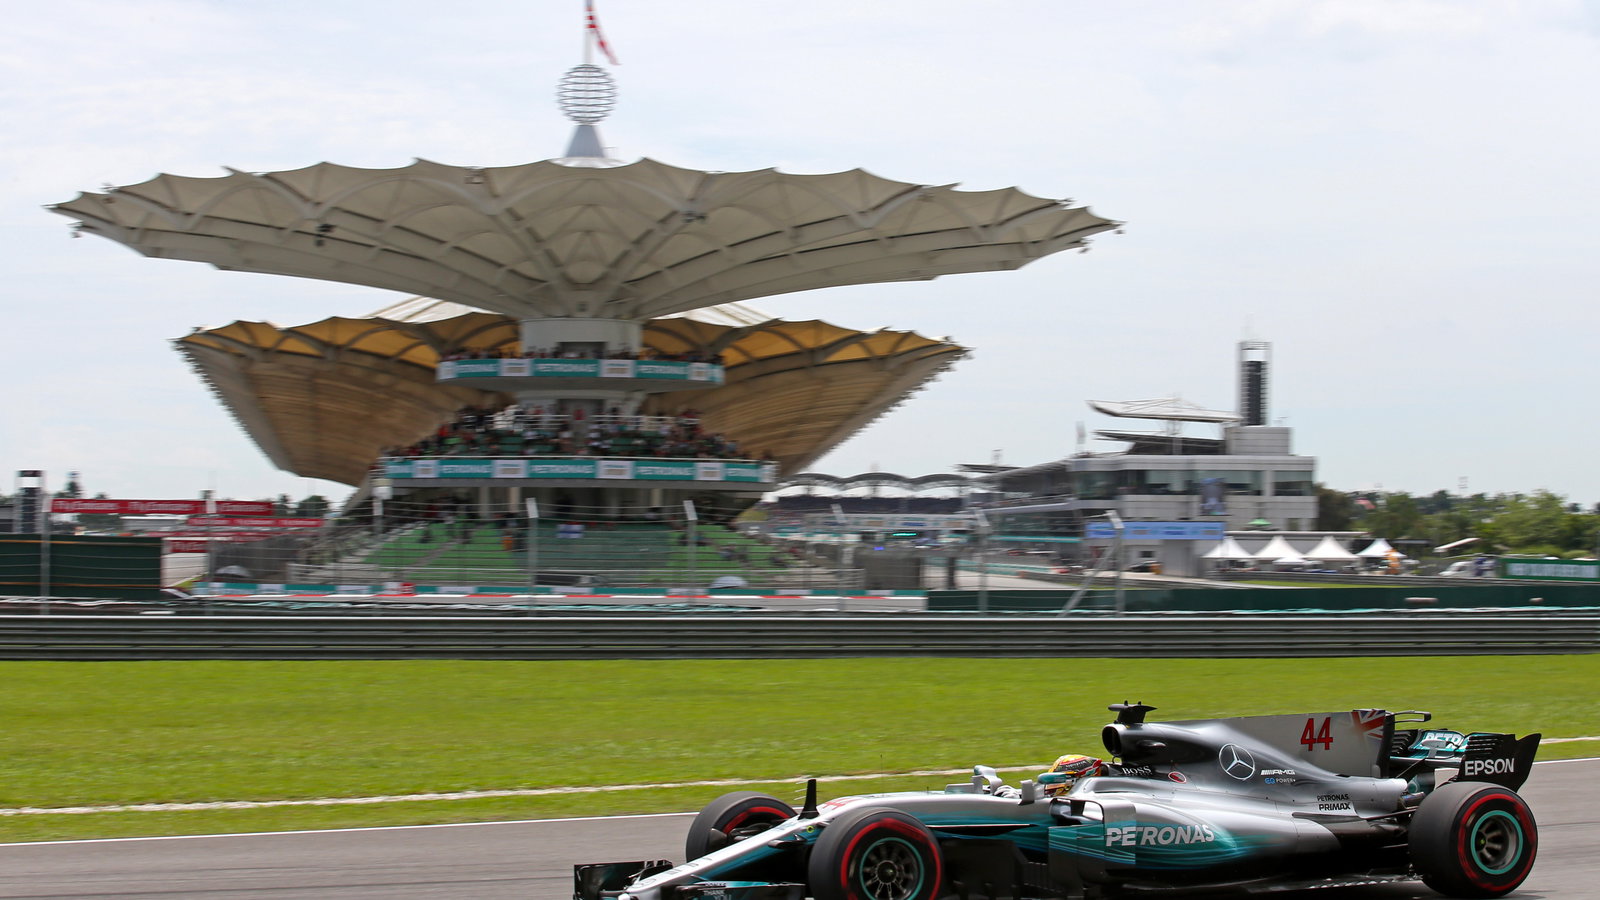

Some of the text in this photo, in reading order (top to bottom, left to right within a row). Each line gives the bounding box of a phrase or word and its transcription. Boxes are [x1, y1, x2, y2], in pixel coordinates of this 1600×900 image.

[1300, 716, 1334, 751] 44
[1122, 765, 1152, 774] BOSS
[1465, 758, 1514, 775] EPSON
[1316, 793, 1350, 802] PETRONAS
[1318, 802, 1351, 812] PRIMAX
[1106, 825, 1215, 847] PETRONAS
